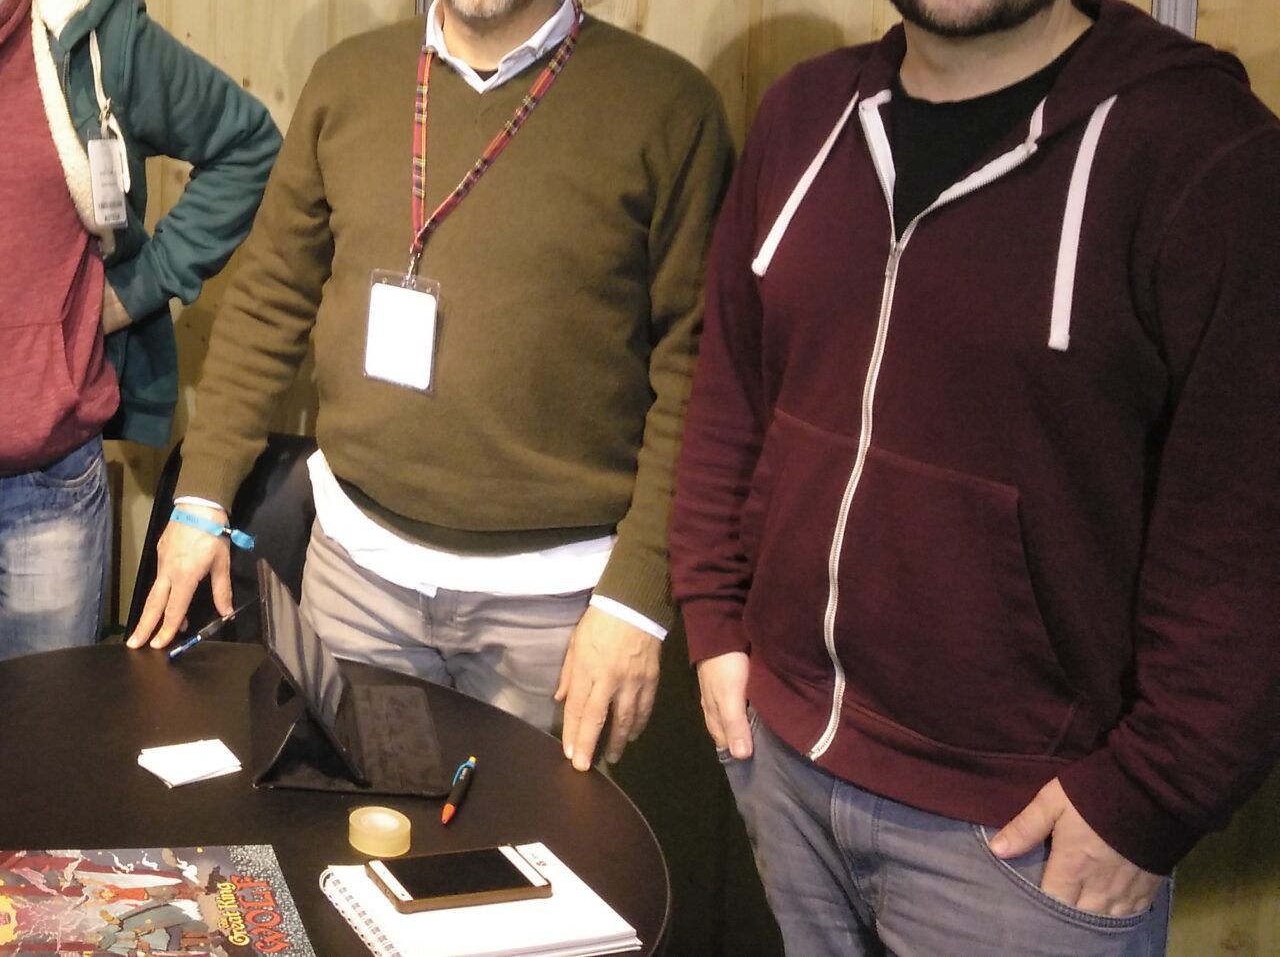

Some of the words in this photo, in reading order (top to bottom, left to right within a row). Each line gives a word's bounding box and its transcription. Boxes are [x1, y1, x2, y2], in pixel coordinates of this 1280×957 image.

[216, 882, 239, 911] King
[230, 874, 294, 953] WOLF
[223, 910, 250, 946] Great
